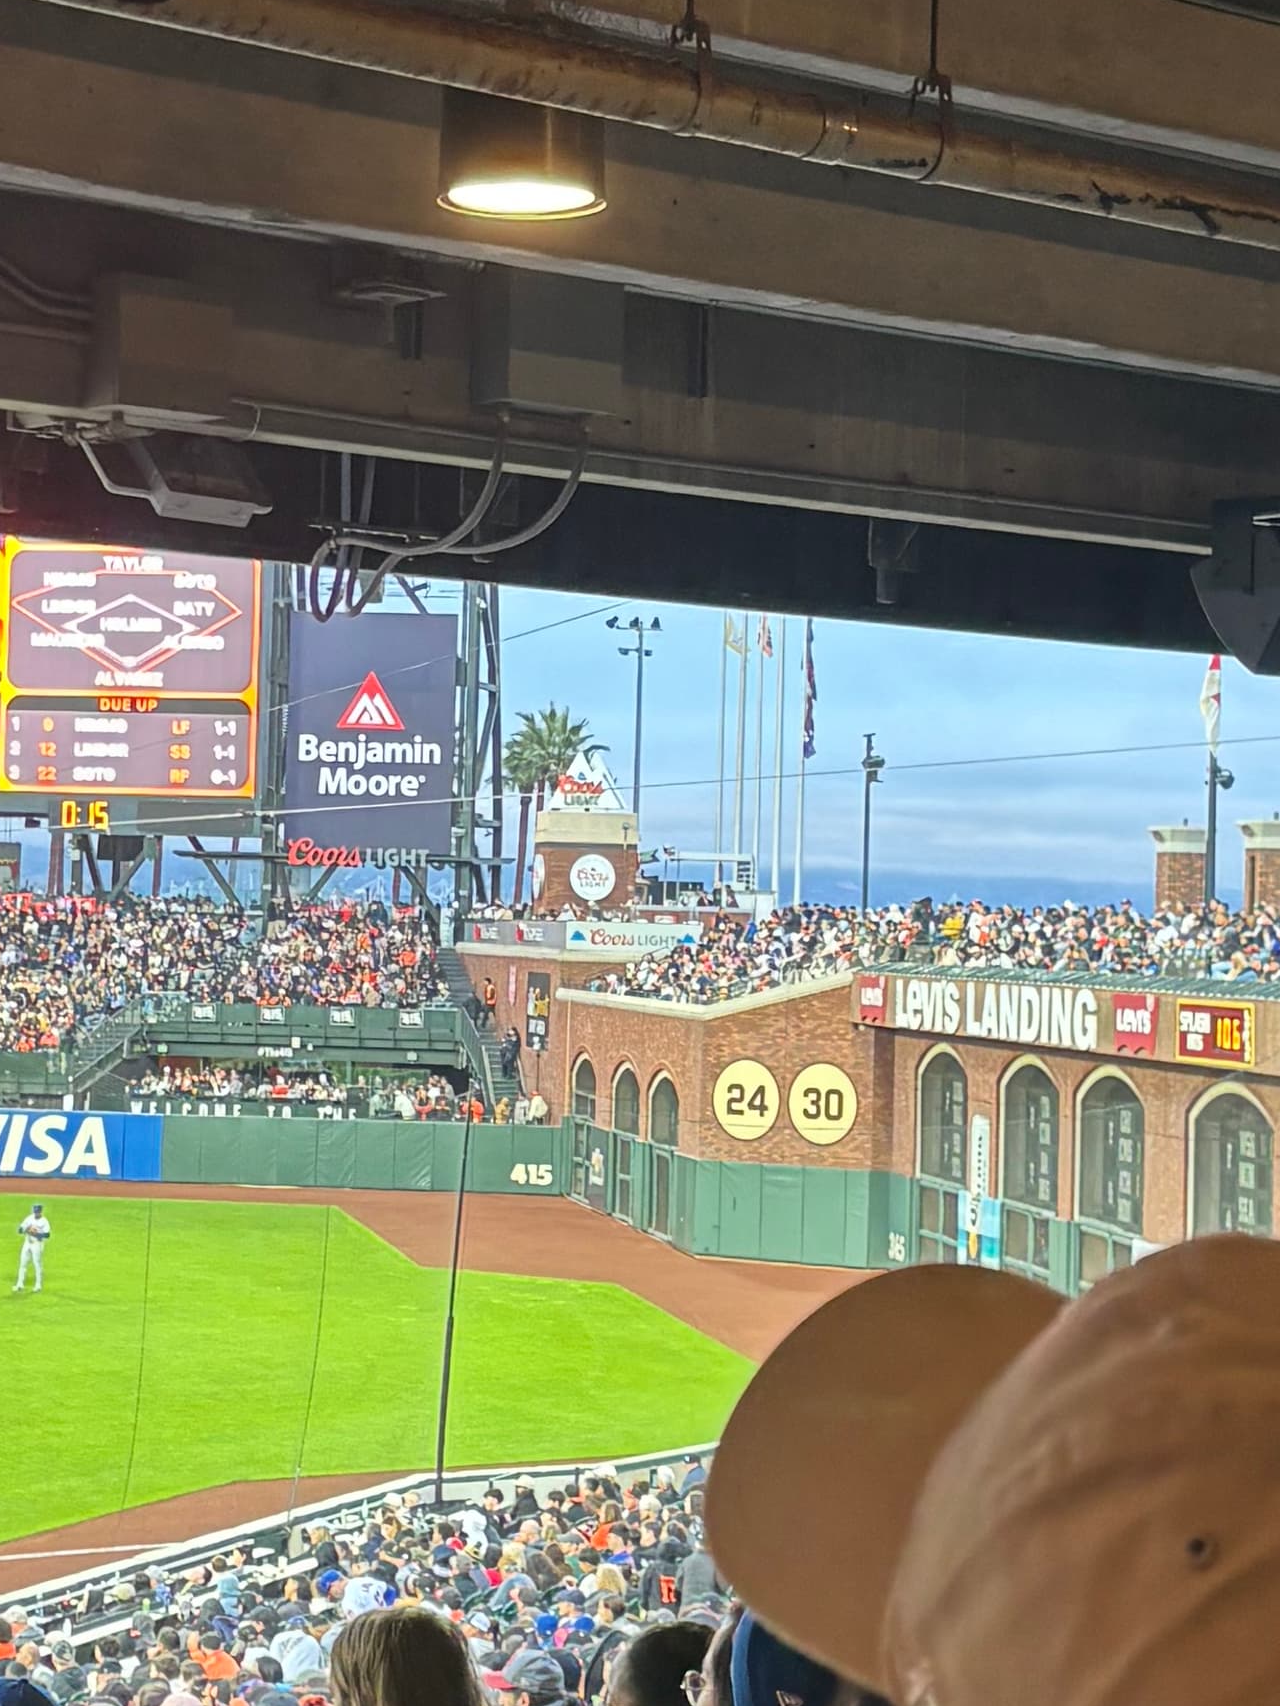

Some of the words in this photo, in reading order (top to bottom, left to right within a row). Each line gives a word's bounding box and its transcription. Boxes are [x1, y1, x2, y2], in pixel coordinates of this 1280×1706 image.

[99, 698, 131, 712] DUE
[135, 699, 158, 713] UP
[11, 716, 20, 732] 1
[171, 720, 191, 735] LF
[213, 720, 237, 736] 1-1
[37, 742, 57, 757] 12
[169, 745, 191, 760] SS
[213, 744, 236, 761] 1-1
[298, 734, 441, 769] Benjamin
[37, 766, 57, 782] 22
[169, 768, 190, 784] RF
[317, 767, 420, 797] Moore
[60, 800, 110, 830] 0:15
[287, 837, 363, 869] Coors
[366, 847, 430, 868] LIGHT
[589, 927, 635, 946] Coors
[637, 934, 678, 948] LIGHT
[965, 981, 1099, 1052] LANDING
[1216, 1018, 1241, 1051] 106
[726, 1083, 769, 1118] 24
[802, 1087, 844, 1121] 30
[510, 1163, 553, 1186] 415
